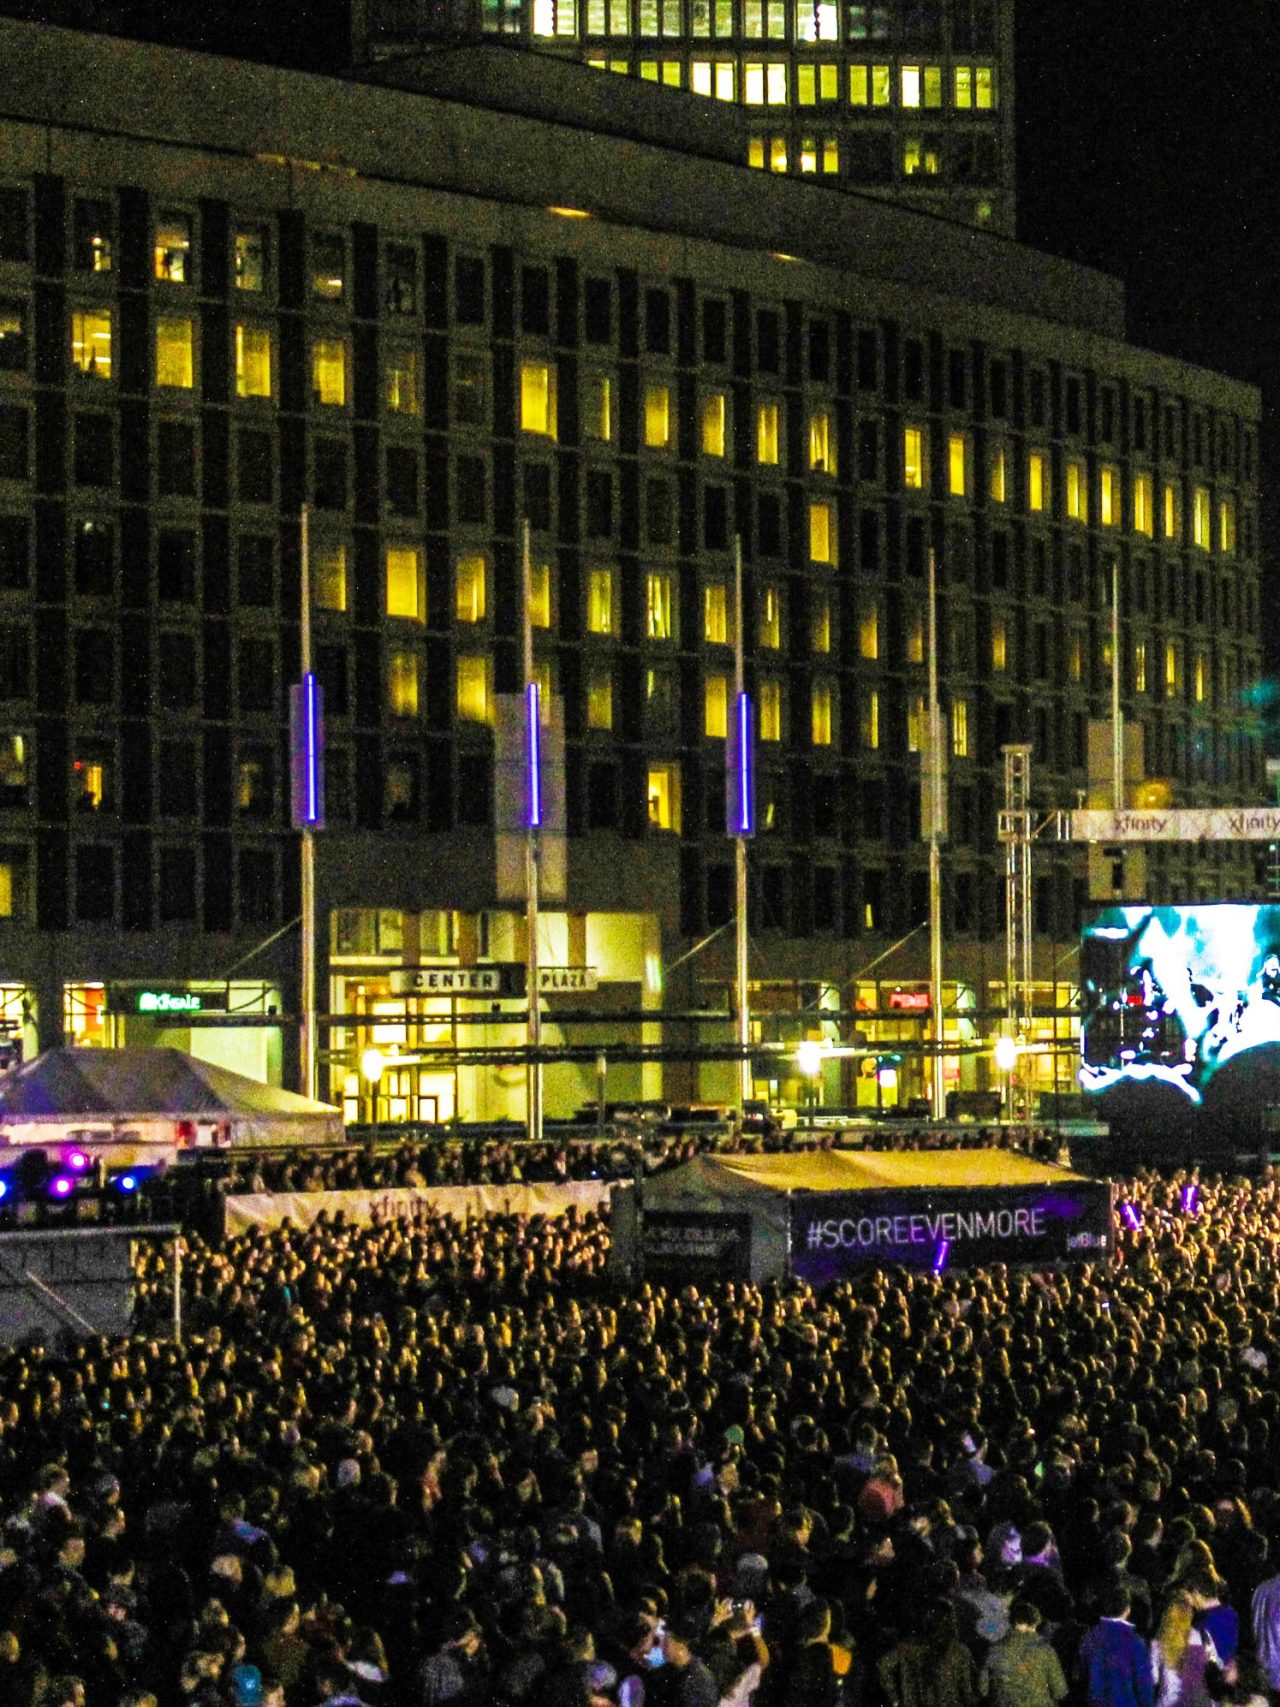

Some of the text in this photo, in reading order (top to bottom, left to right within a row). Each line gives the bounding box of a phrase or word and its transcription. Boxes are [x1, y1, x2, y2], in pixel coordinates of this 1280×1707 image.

[1113, 815, 1168, 834] xfinity
[412, 973, 587, 988] CENTER PLAZA
[806, 1207, 1047, 1249] #SCOREEVENMORE
